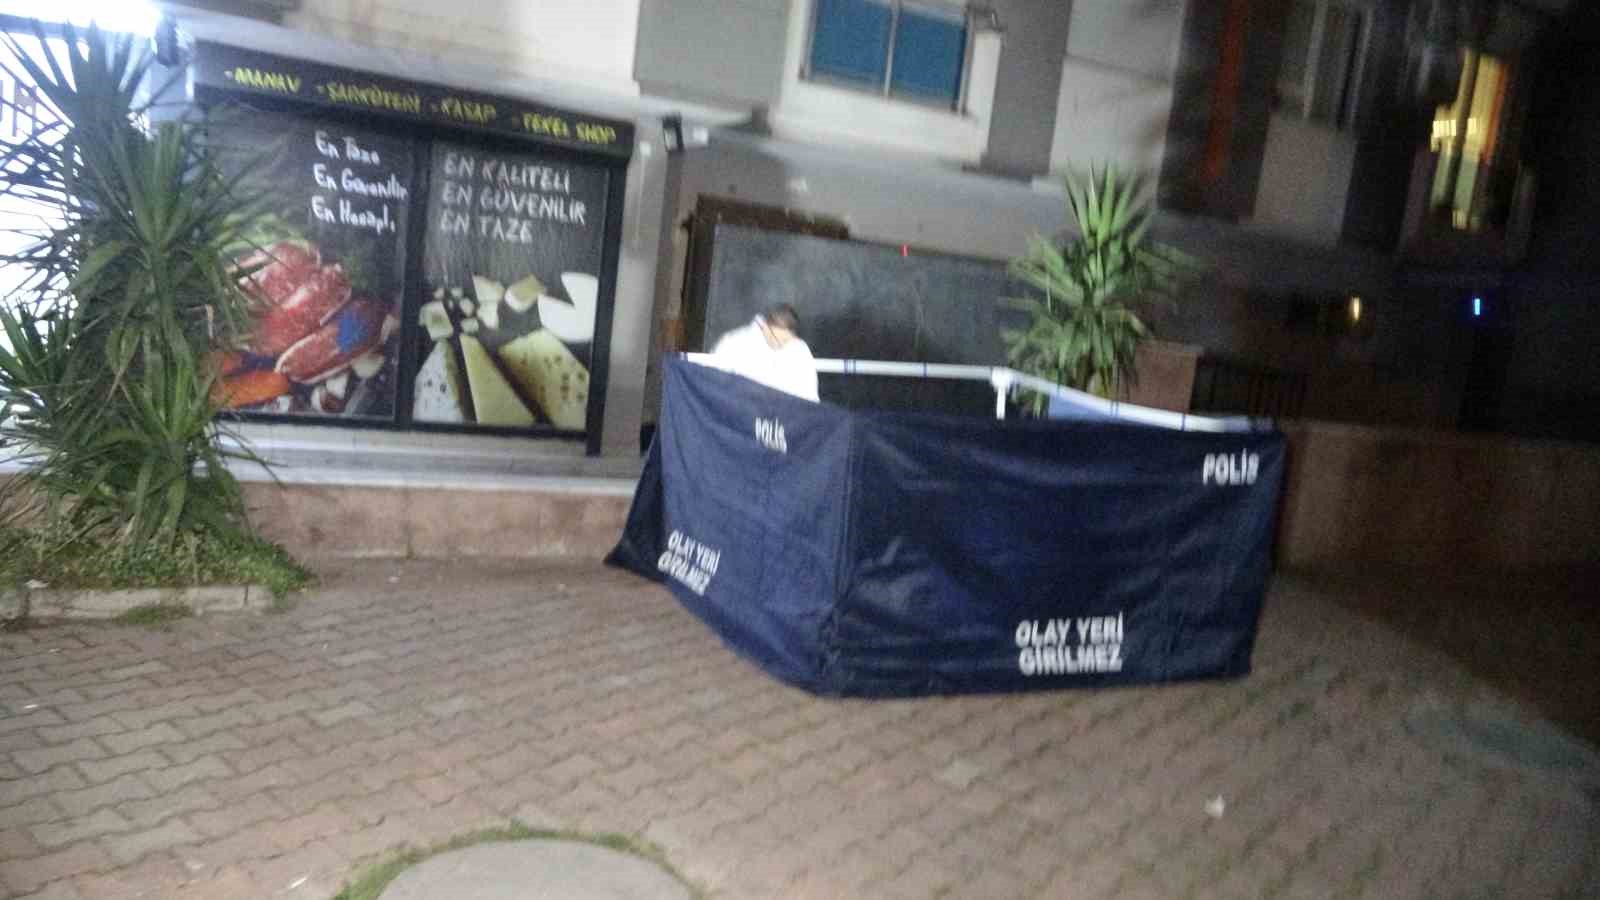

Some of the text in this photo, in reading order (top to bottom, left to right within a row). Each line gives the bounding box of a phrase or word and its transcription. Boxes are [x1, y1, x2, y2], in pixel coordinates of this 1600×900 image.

[315, 130, 340, 160] En
[313, 163, 338, 192] En
[444, 152, 475, 178] EN
[442, 181, 473, 206] EN
[311, 195, 336, 224] En
[440, 210, 533, 244] EN TAZE
[1202, 448, 1260, 486] POLİS
[668, 529, 697, 563] OLAY
[1015, 617, 1071, 648] OLAY
